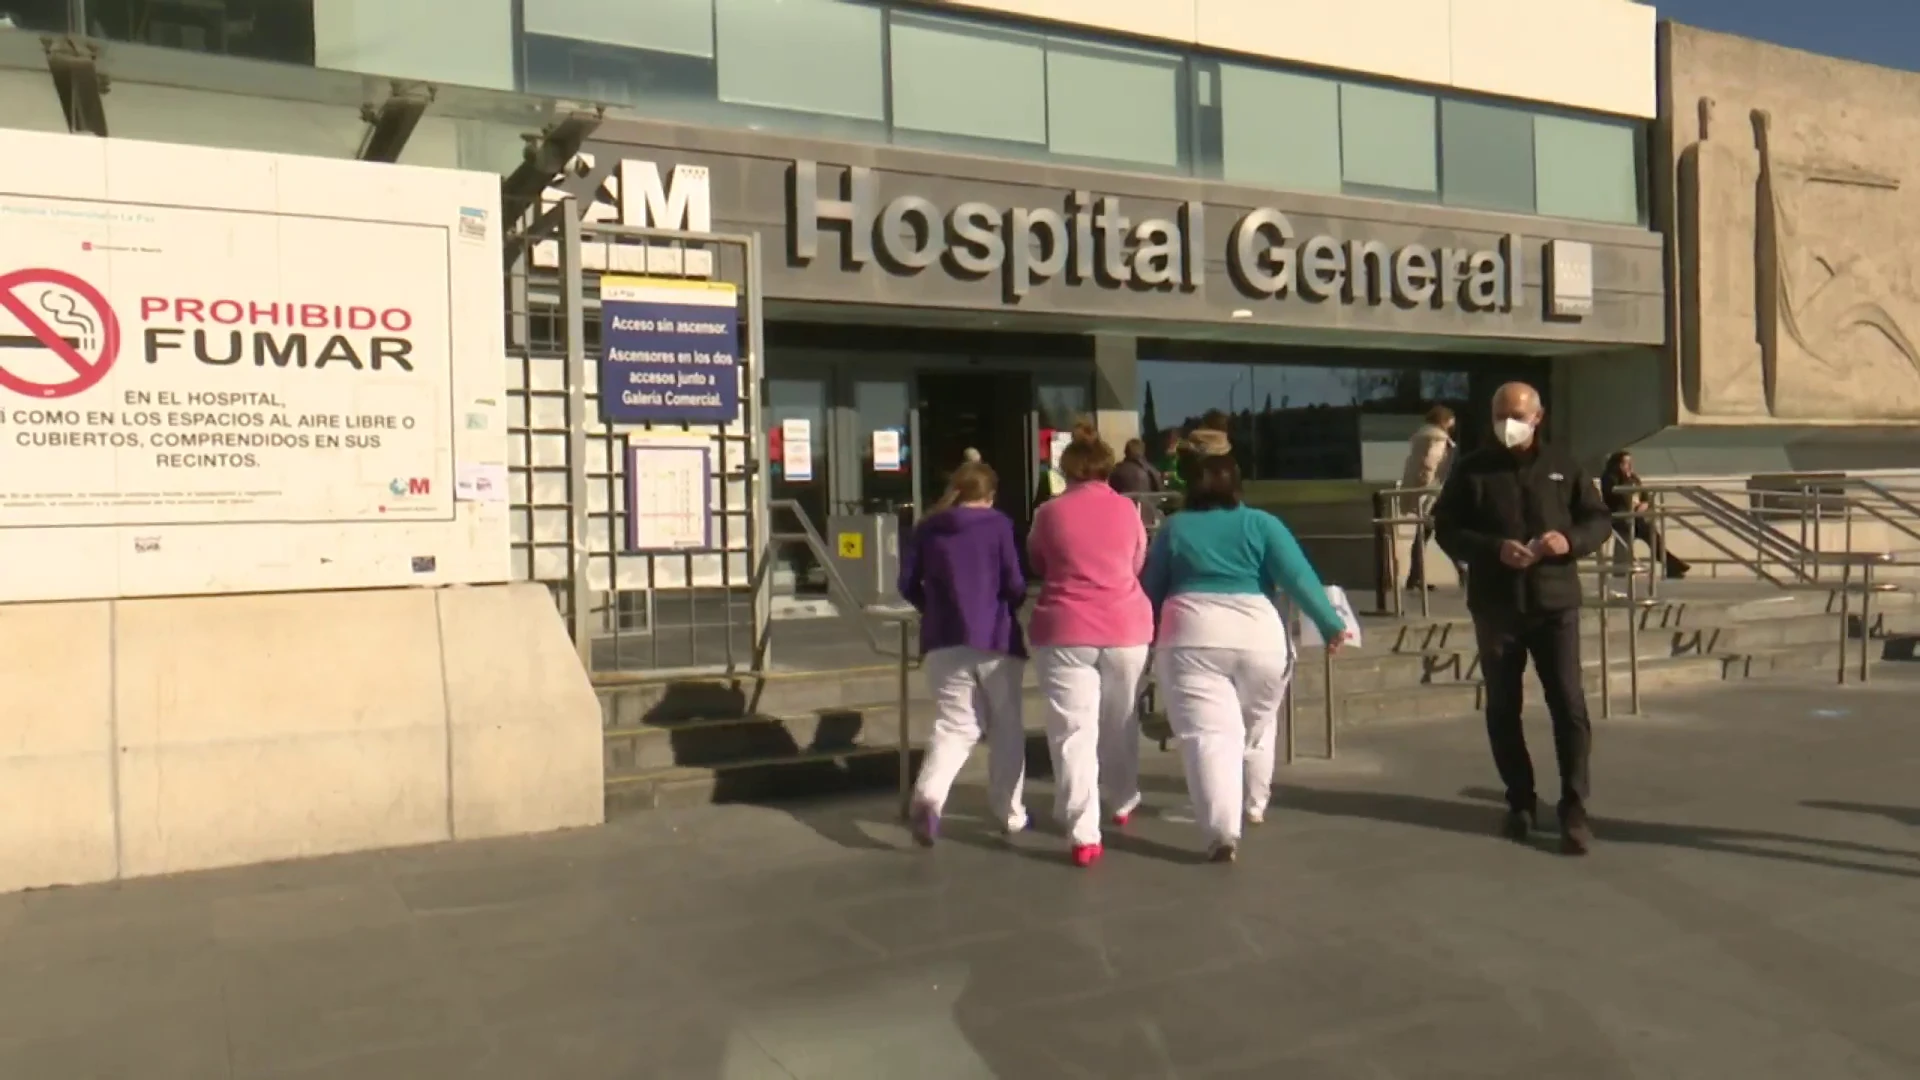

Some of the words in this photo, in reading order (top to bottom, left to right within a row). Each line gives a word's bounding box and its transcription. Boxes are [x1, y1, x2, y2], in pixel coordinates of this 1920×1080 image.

[793, 158, 1205, 297] Hospital
[1233, 206, 1523, 308] General
[141, 296, 412, 332] PROHIBIDO
[612, 315, 655, 332] Acceso
[657, 318, 674, 333] sin
[676, 320, 729, 335] ascensor.
[144, 328, 414, 372] FUMAR
[608, 347, 676, 364] Ascensores
[678, 351, 692, 364] en
[694, 350, 711, 365] los
[713, 351, 733, 365] dos
[629, 371, 676, 385] accesos
[677, 370, 706, 388] junto
[708, 374, 716, 386] a
[124, 390, 151, 405] EN
[157, 391, 182, 405] EL
[187, 391, 286, 408] HOSPITAL,
[664, 390, 723, 407] Comercial.
[12, 410, 80, 426] COMO
[86, 411, 115, 426] EN
[122, 411, 162, 426] LOS
[167, 412, 264, 427] ESPACIOS
[269, 413, 292, 428] AL
[297, 414, 340, 429] AIRE
[345, 415, 397, 429] LIBRE
[401, 415, 416, 430] O
[15, 431, 145, 448] CUBIERTOS,
[150, 432, 310, 449] COMPRENDIDOS
[315, 434, 340, 448] EN
[345, 434, 381, 449] SUS
[156, 453, 261, 468] RECINTOS.
